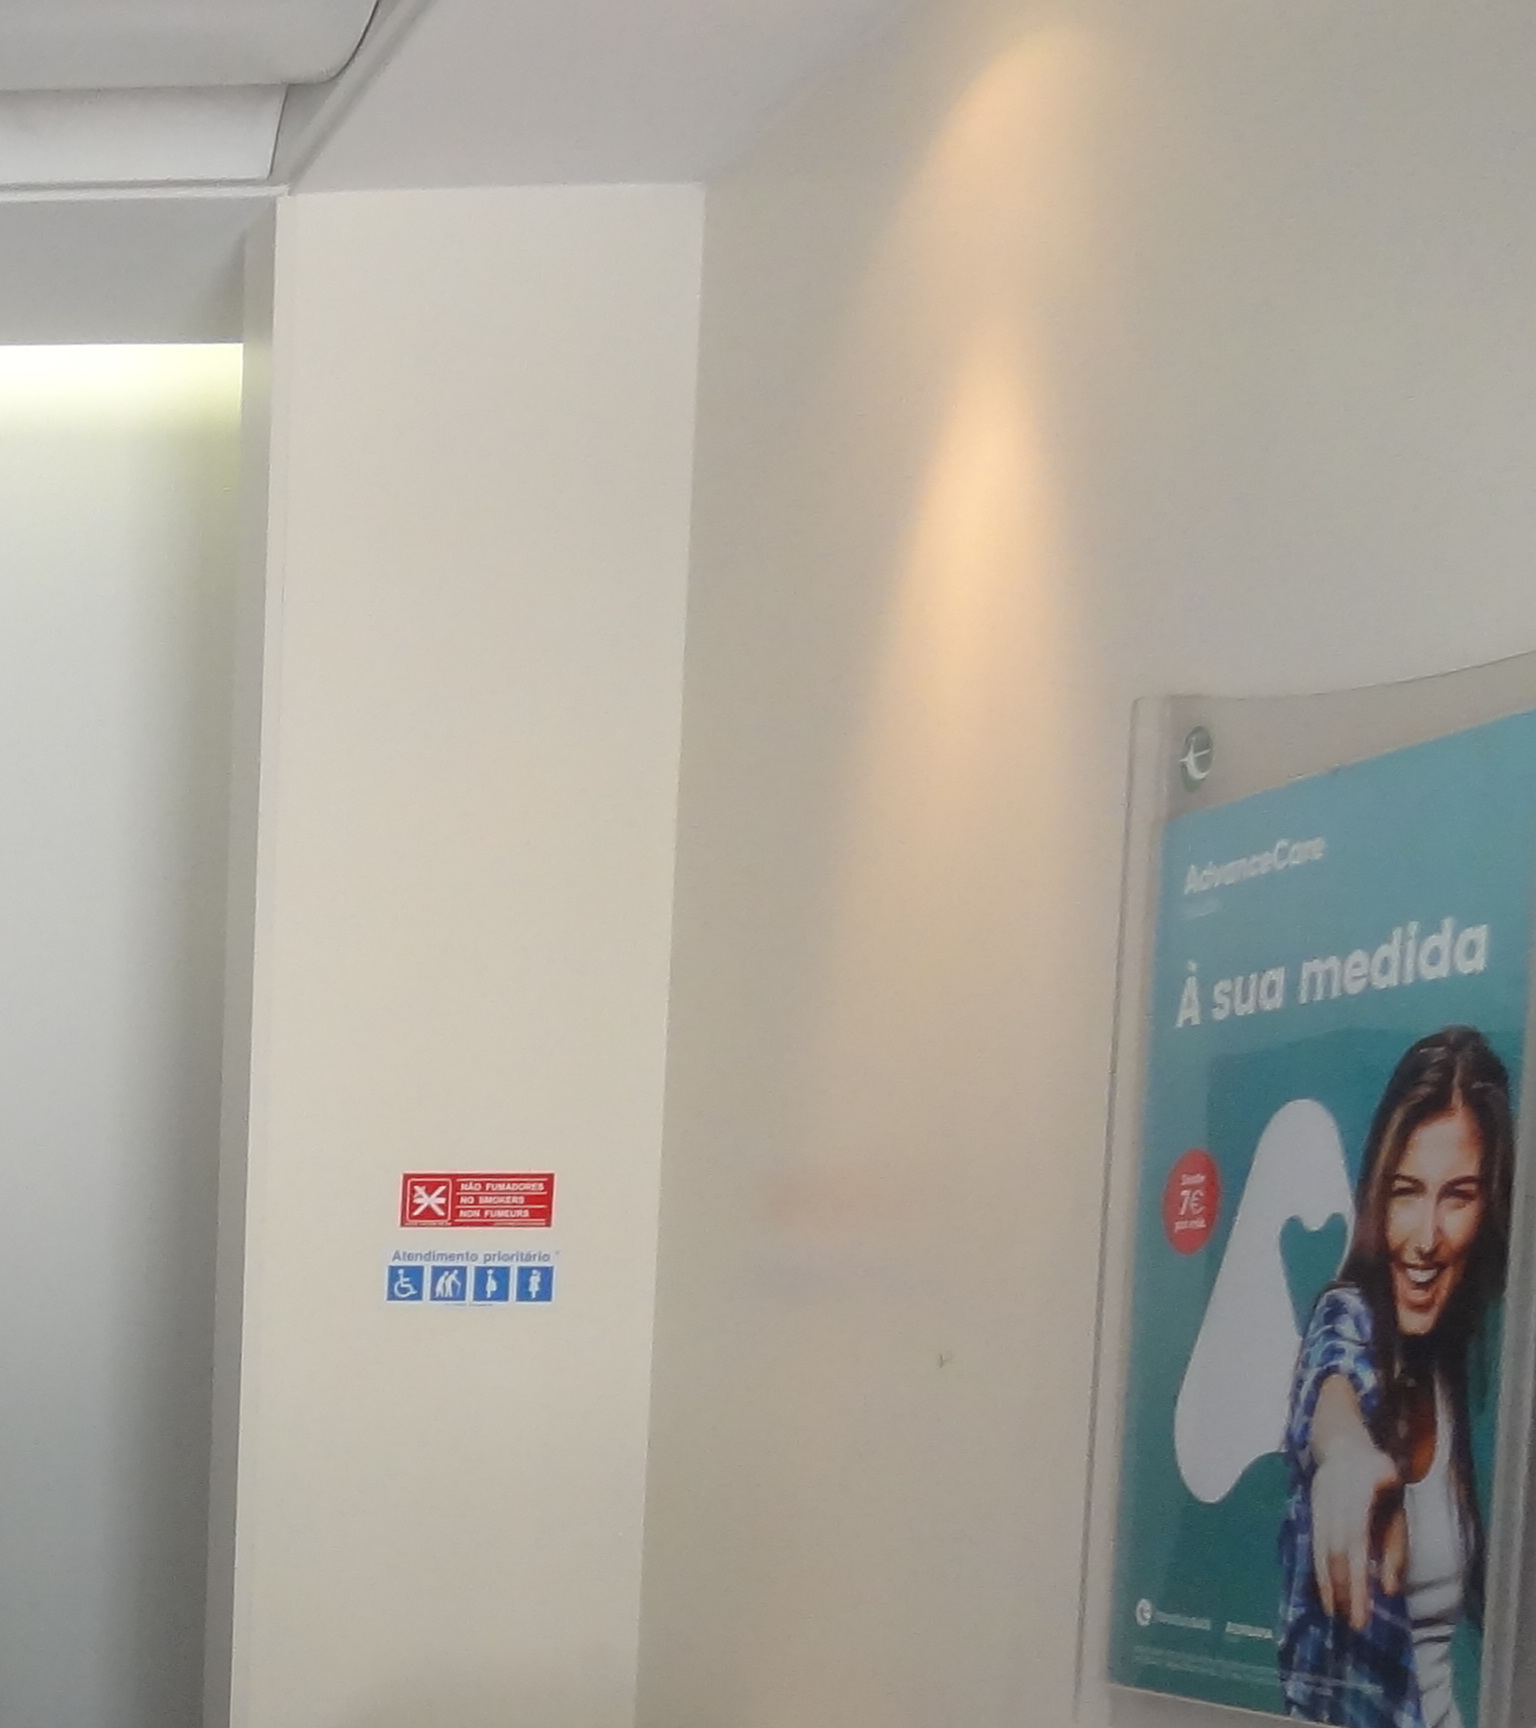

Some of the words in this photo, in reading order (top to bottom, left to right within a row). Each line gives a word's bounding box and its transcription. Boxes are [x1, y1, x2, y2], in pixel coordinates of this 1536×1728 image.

[1211, 965, 1287, 1022] sua
[1298, 916, 1490, 1005] medida
[459, 1181, 482, 1192] NÃO
[485, 1181, 545, 1192] FUMADORES
[459, 1195, 475, 1205] NO
[391, 1250, 479, 1263] Atendimento
[483, 1250, 551, 1265] prioritário
